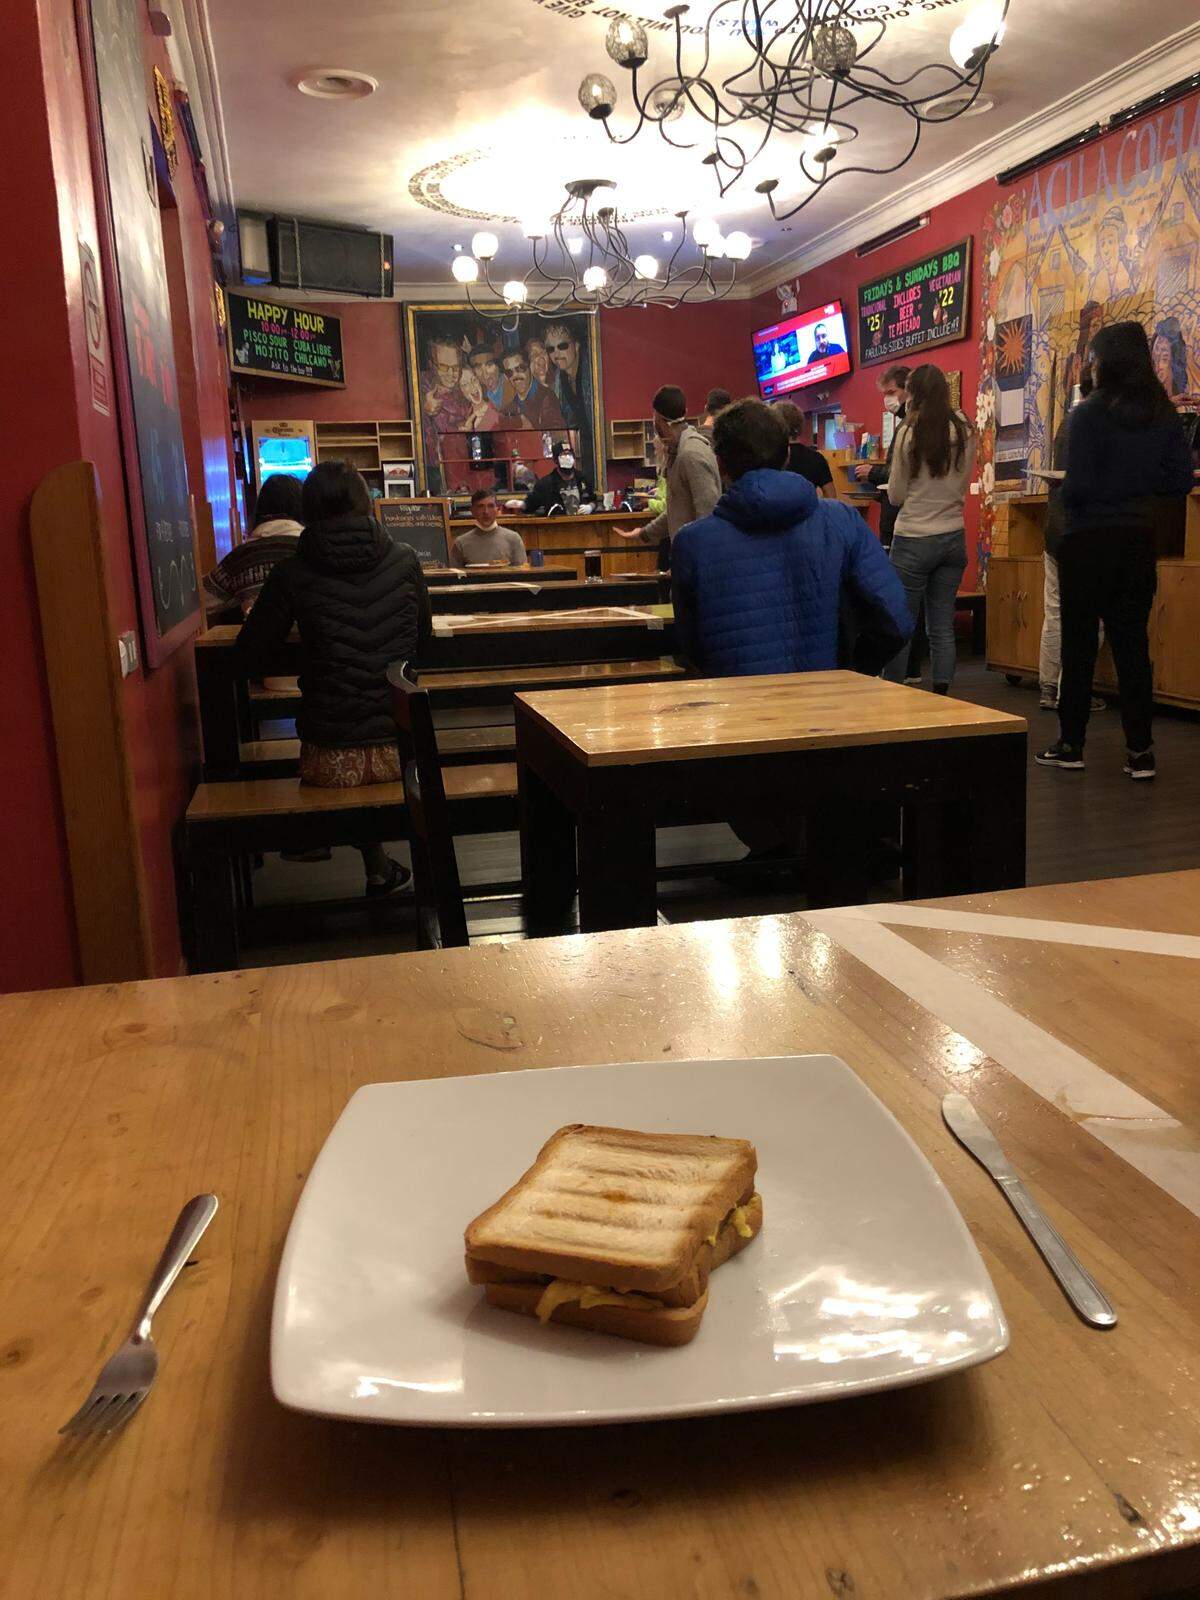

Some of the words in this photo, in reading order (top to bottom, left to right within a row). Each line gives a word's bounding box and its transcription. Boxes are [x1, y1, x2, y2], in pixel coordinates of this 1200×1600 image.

[895, 276, 902, 291] &
[942, 251, 960, 272] BBQ
[893, 285, 922, 309] INCLUDES
[247, 300, 288, 325] HAPPY
[294, 311, 325, 334] HOUR
[243, 329, 268, 344] PISCO
[270, 334, 288, 348] SOUR
[293, 340, 311, 353] CUBA
[312, 344, 333, 357] LIBRE
[905, 330, 925, 347] BUFFET
[255, 345, 289, 361] MOJITO
[294, 352, 327, 368] CHILCANO
[271, 361, 281, 370] Ask
